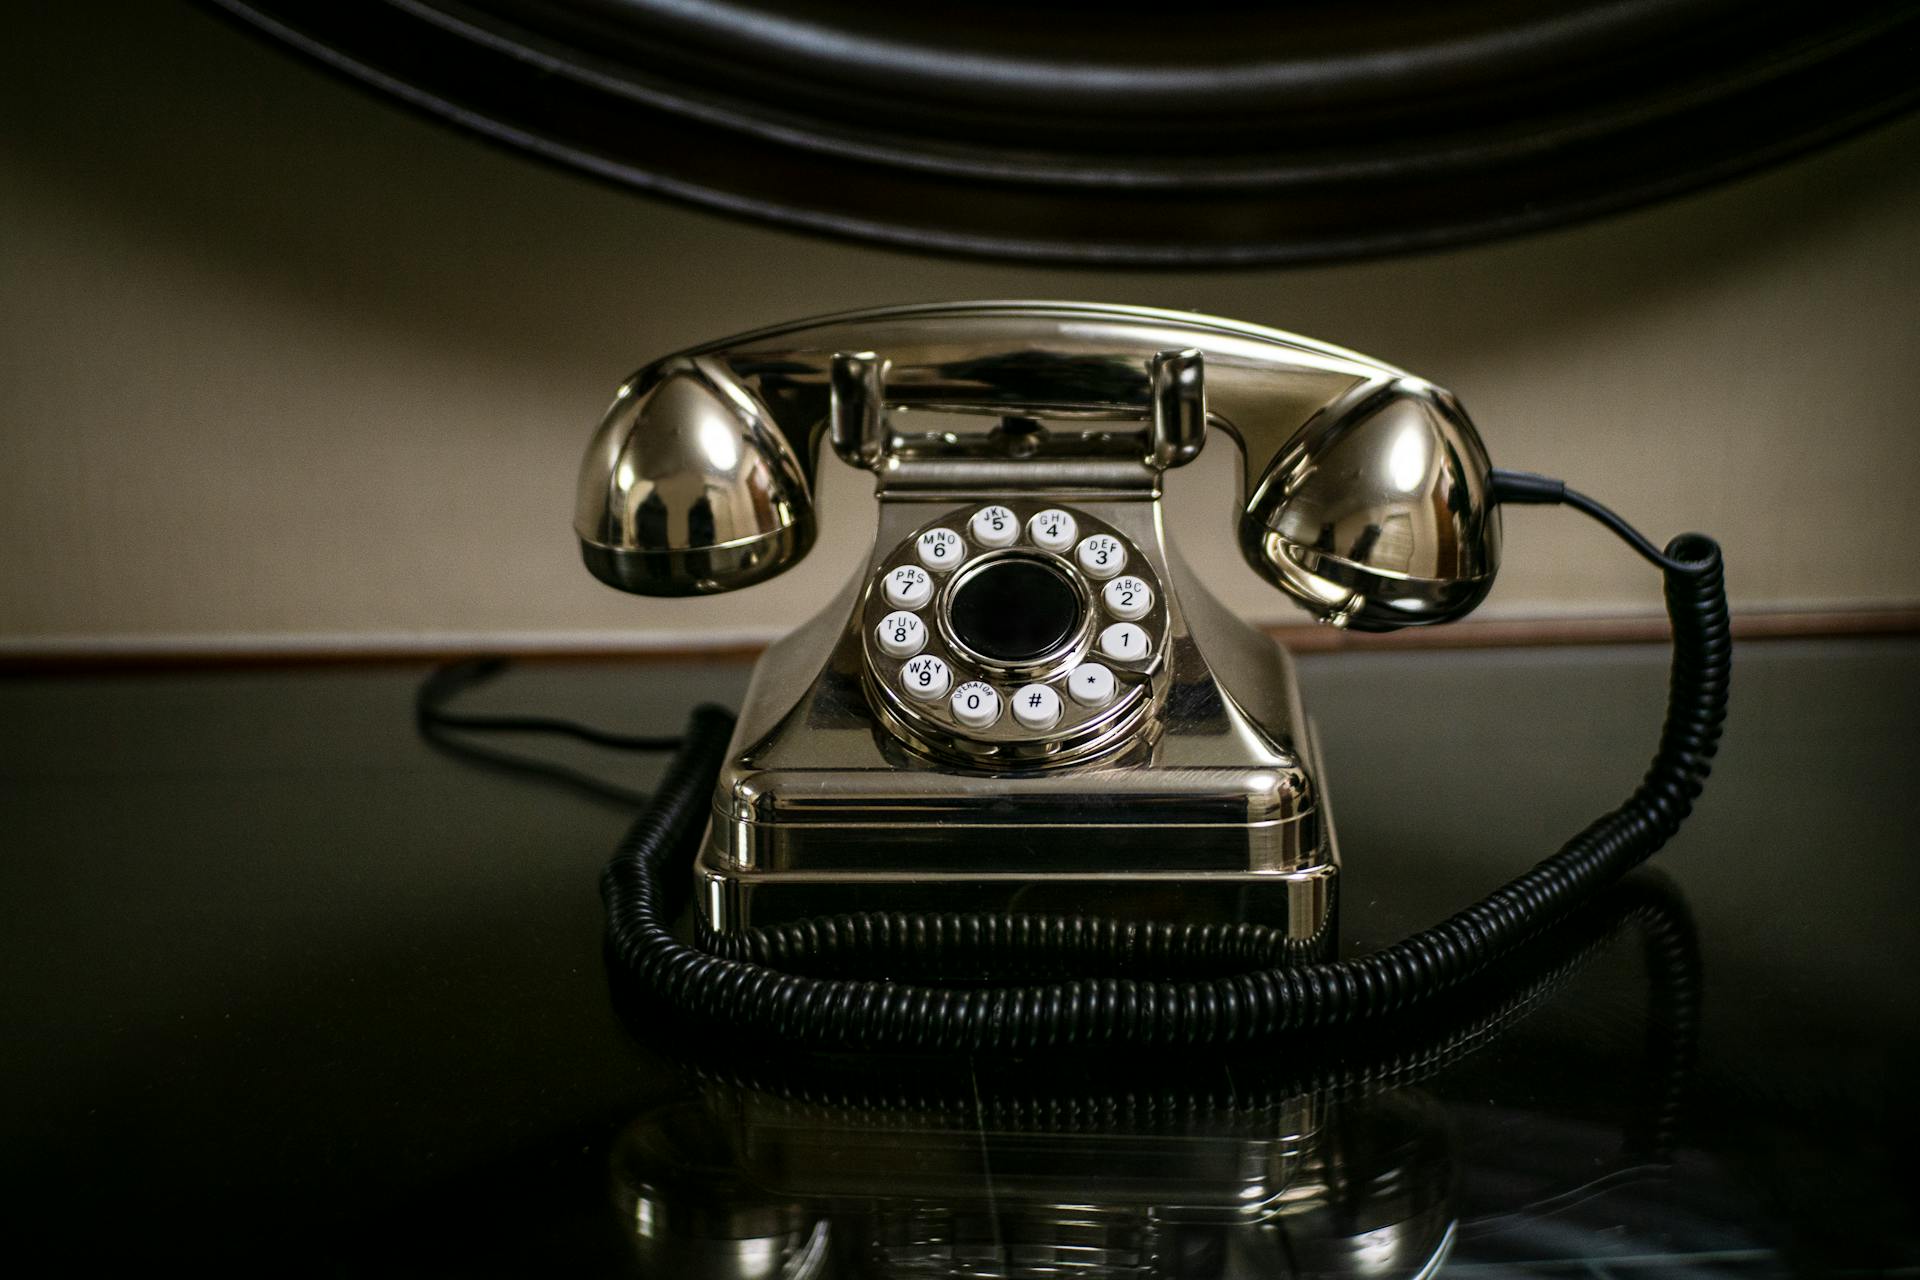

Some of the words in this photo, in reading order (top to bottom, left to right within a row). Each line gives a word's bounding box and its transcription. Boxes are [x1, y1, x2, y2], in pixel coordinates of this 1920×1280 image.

[984, 508, 1009, 521] JKL
[1040, 513, 1066, 526] GHI
[992, 517, 1004, 530] 5
[1046, 524, 1058, 537] 4
[923, 532, 956, 545] MNO
[1089, 538, 1117, 553] DEF
[934, 543, 946, 557] 6
[1095, 550, 1108, 564] 3
[896, 569, 924, 583] PRS
[902, 581, 914, 595] 7
[1115, 579, 1142, 592] ABC
[1121, 592, 1133, 606] 2
[887, 617, 918, 630] TUV
[894, 627, 906, 642] 8
[1121, 633, 1129, 647] 1
[909, 660, 942, 674] WXY
[919, 671, 931, 686] 9
[967, 694, 980, 709] 0
[1028, 693, 1042, 708] #
